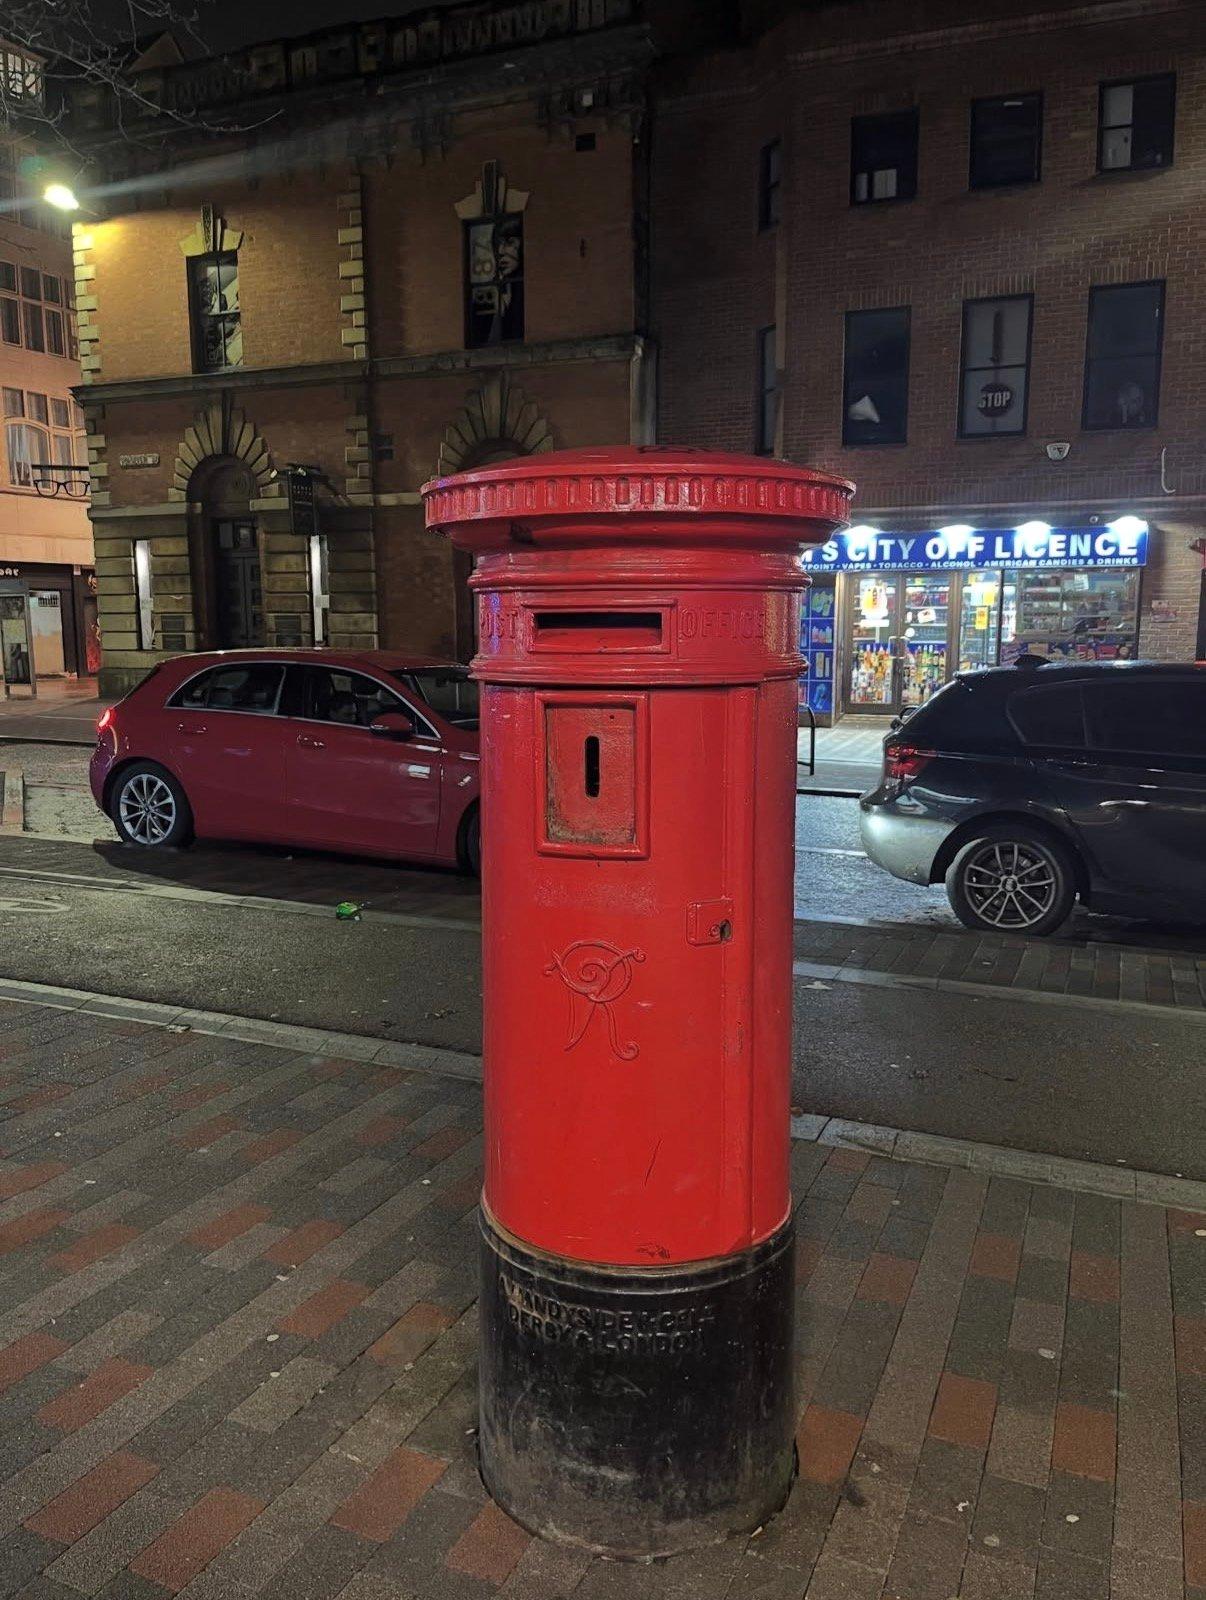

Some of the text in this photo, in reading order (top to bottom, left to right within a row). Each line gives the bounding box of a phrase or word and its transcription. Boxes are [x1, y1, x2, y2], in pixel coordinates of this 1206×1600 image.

[977, 391, 1012, 409] STOP
[847, 538, 916, 562] CITY
[925, 536, 985, 561] OFF
[994, 532, 1138, 559] LICENCE
[842, 562, 872, 570] VAPES
[878, 561, 924, 570] TOBACCO
[930, 560, 976, 569] ALCOHOL
[983, 559, 1037, 568] AMERICAN
[1038, 559, 1084, 567] CANDIES
[1097, 557, 1138, 566] DRINKS
[679, 606, 768, 640] OFFICE
